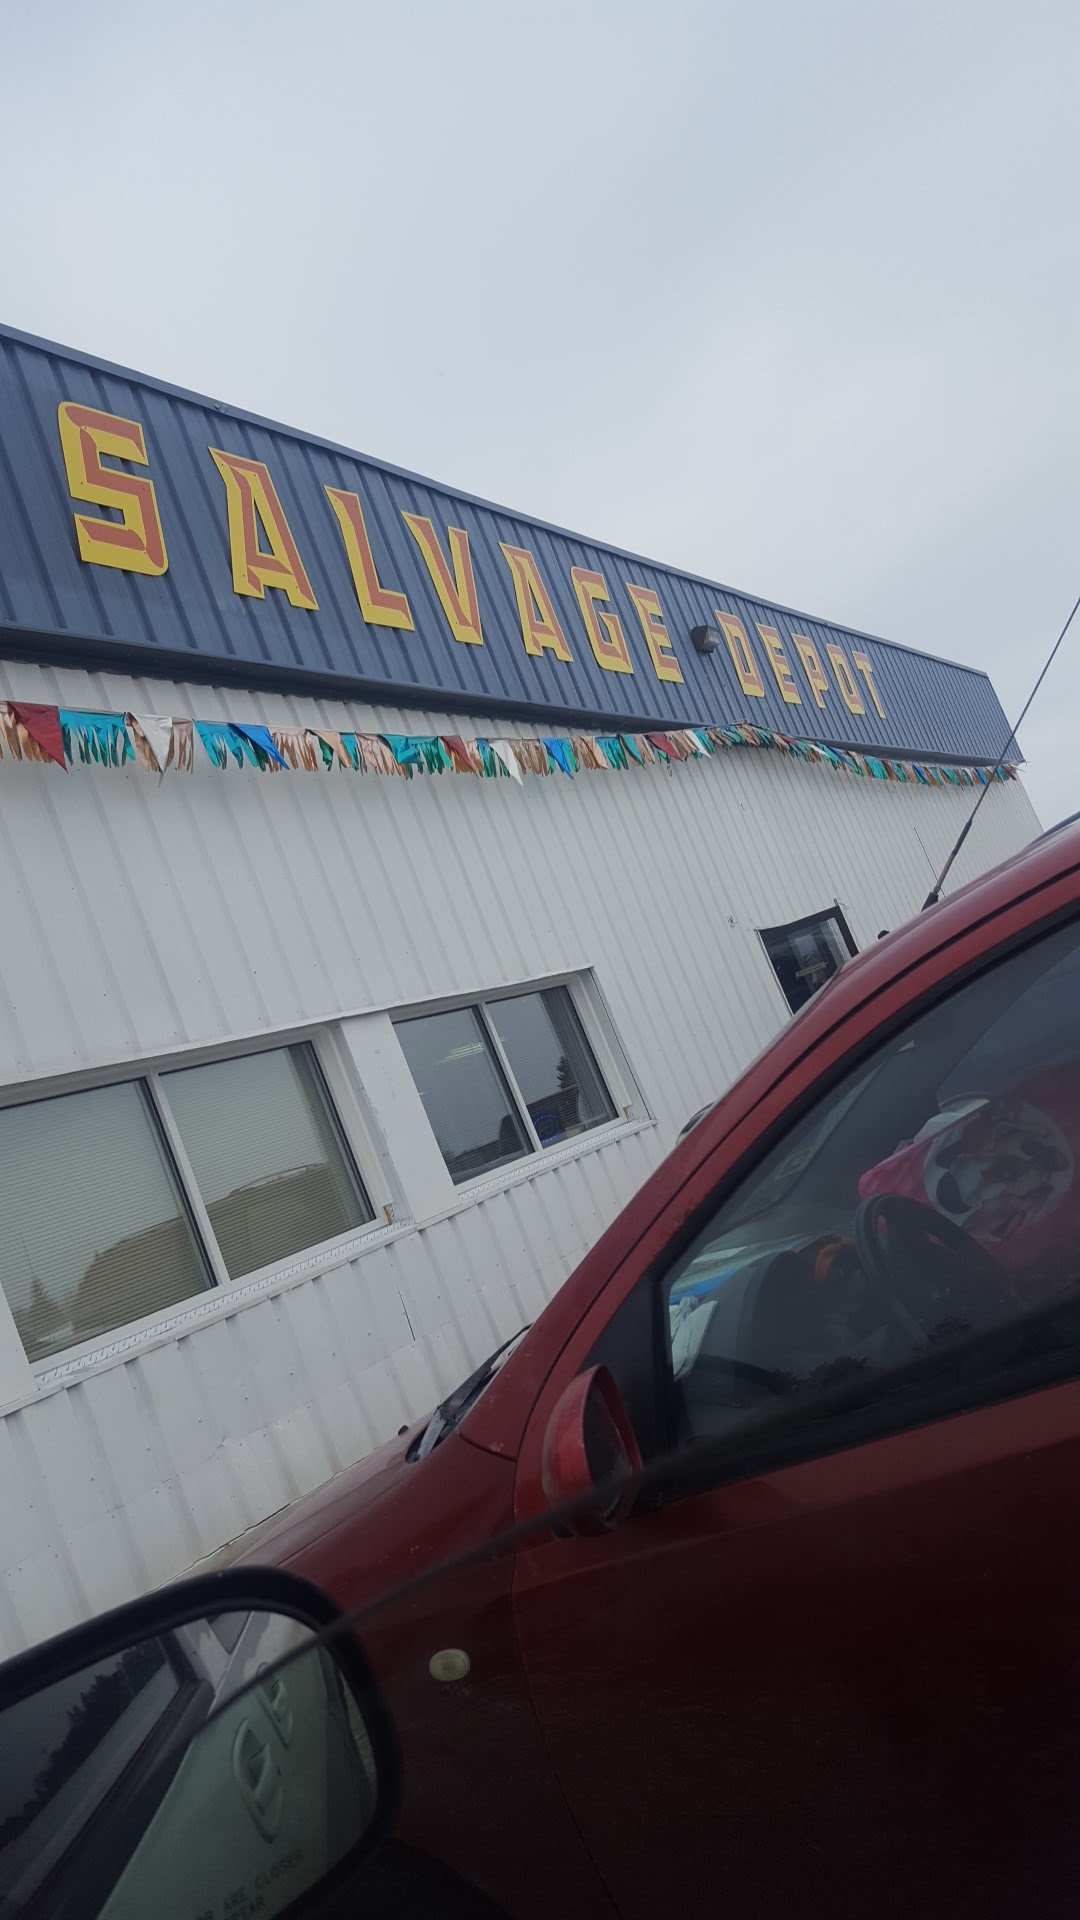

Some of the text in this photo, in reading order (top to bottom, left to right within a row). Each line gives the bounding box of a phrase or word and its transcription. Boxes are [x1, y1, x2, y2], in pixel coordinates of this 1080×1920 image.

[58, 401, 886, 719] SALVAGE DEPOT
[255, 1848, 304, 1889] CLOSER
